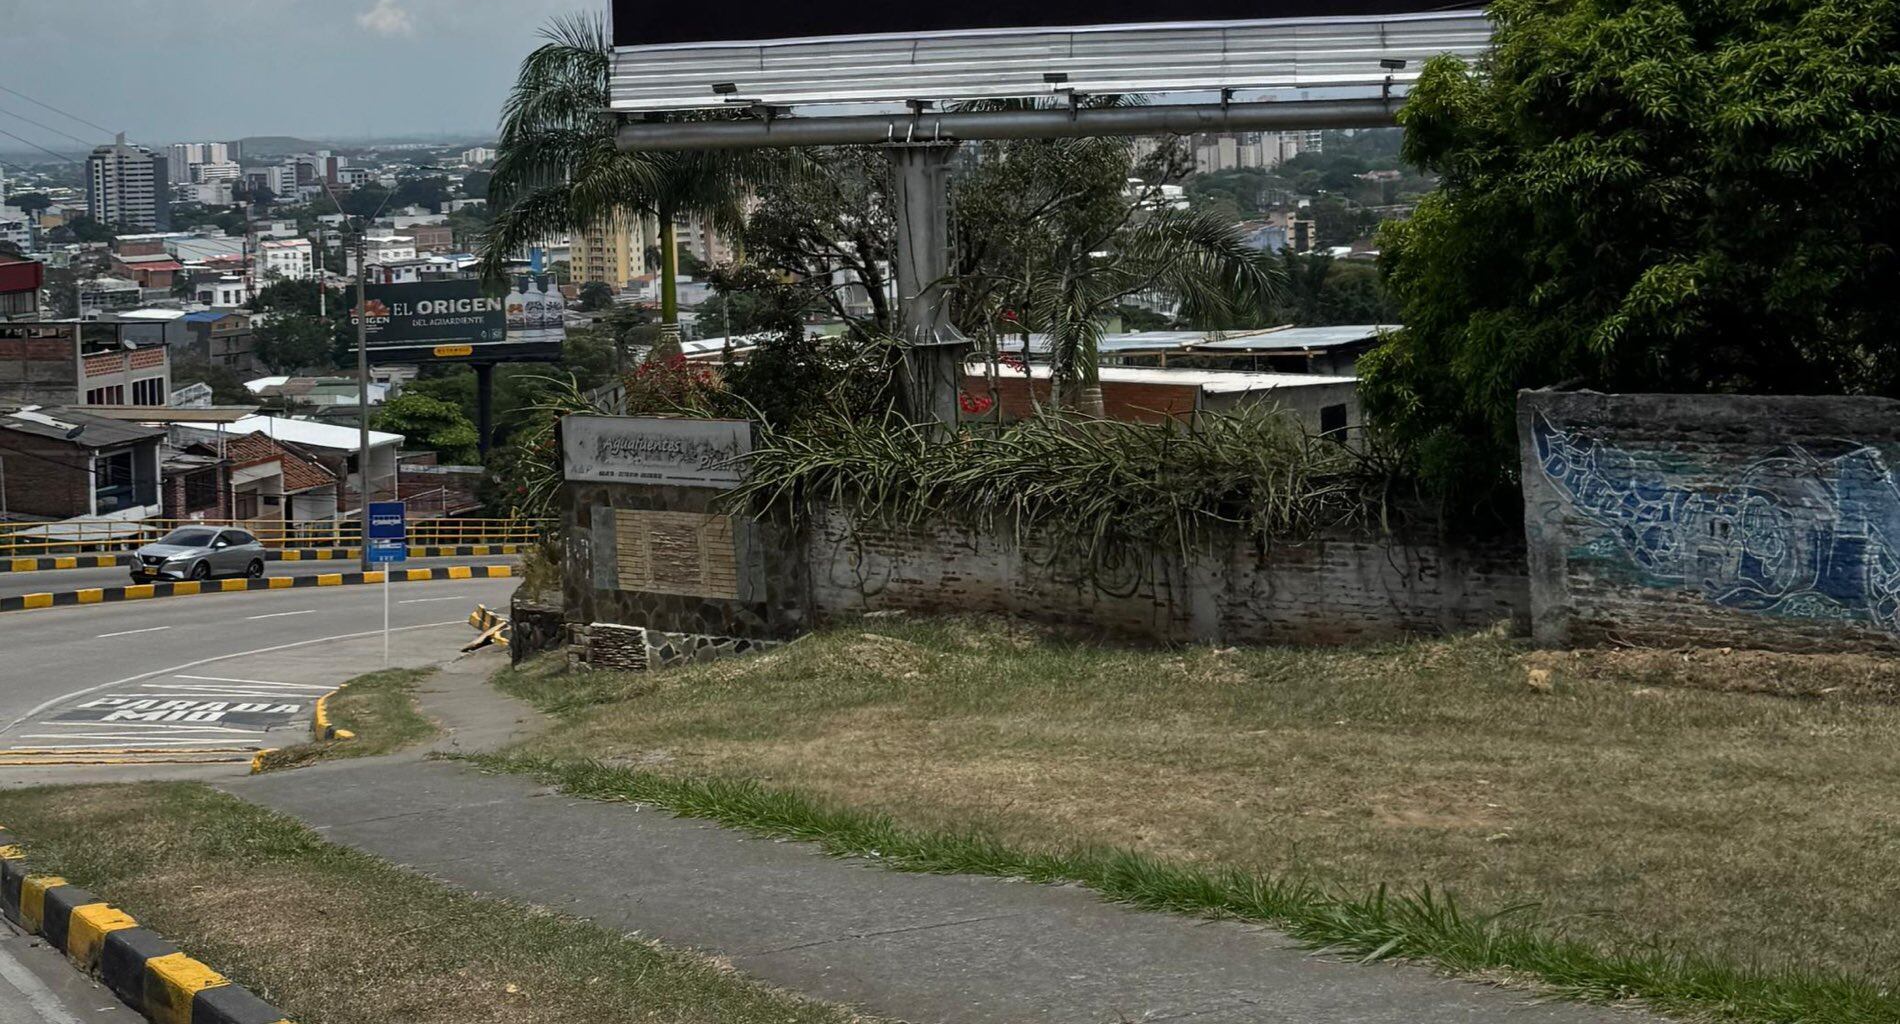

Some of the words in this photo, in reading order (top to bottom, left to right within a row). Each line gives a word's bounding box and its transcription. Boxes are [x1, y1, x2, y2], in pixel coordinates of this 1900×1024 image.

[392, 302, 413, 316] EL
[416, 297, 502, 315] ORIGEN
[351, 316, 390, 325] OIGEN
[412, 319, 429, 327] DEL
[430, 316, 485, 326] AGUARDIENTE
[77, 697, 300, 713] PARADA
[101, 709, 226, 722] MIO
